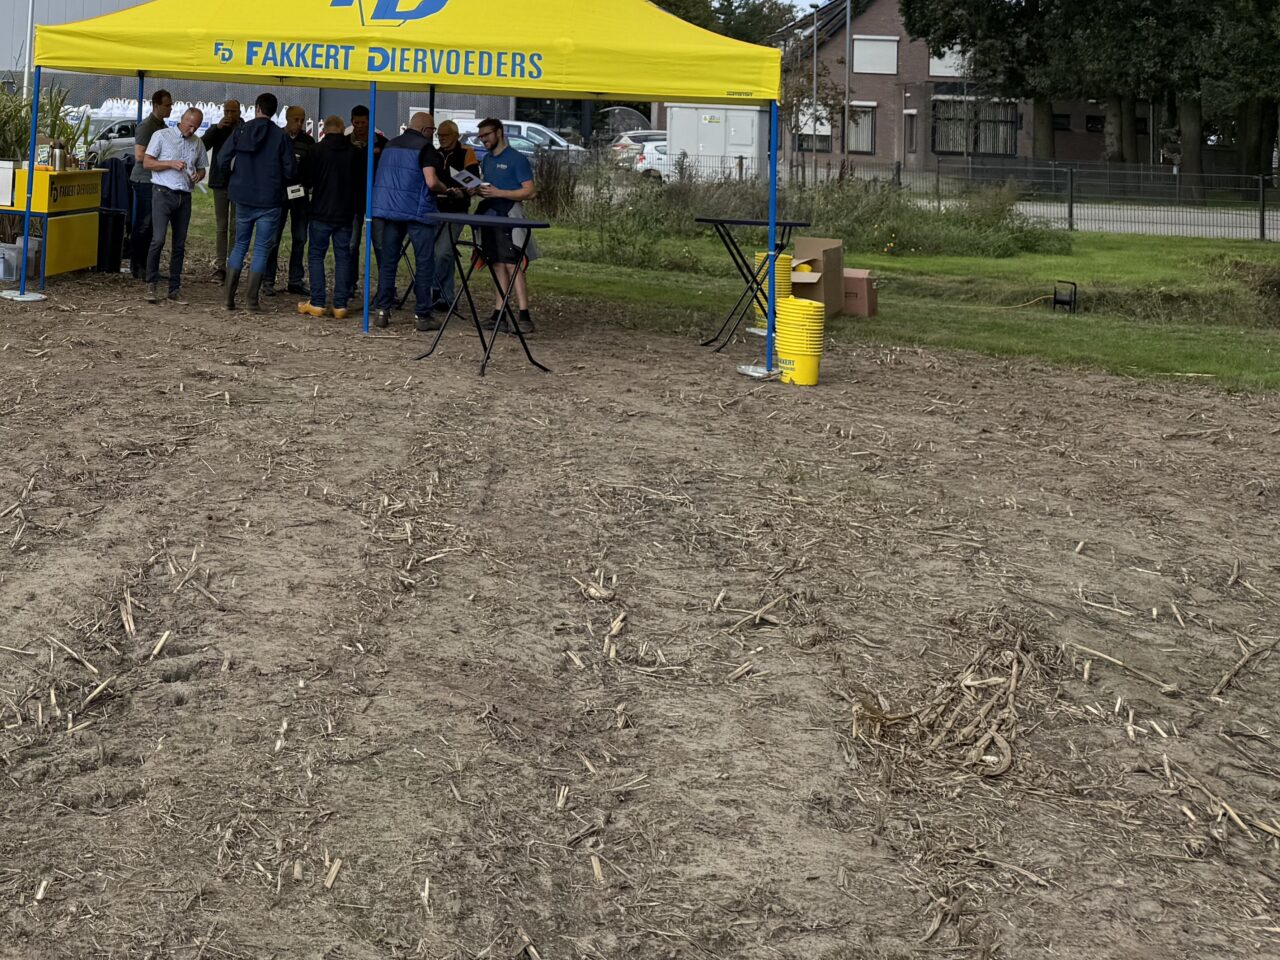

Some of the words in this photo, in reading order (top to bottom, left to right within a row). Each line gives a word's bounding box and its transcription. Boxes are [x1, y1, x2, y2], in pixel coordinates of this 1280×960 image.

[214, 42, 234, 62] FD
[245, 41, 355, 71] FAKKERT
[367, 46, 543, 79] DIERVOEDERS
